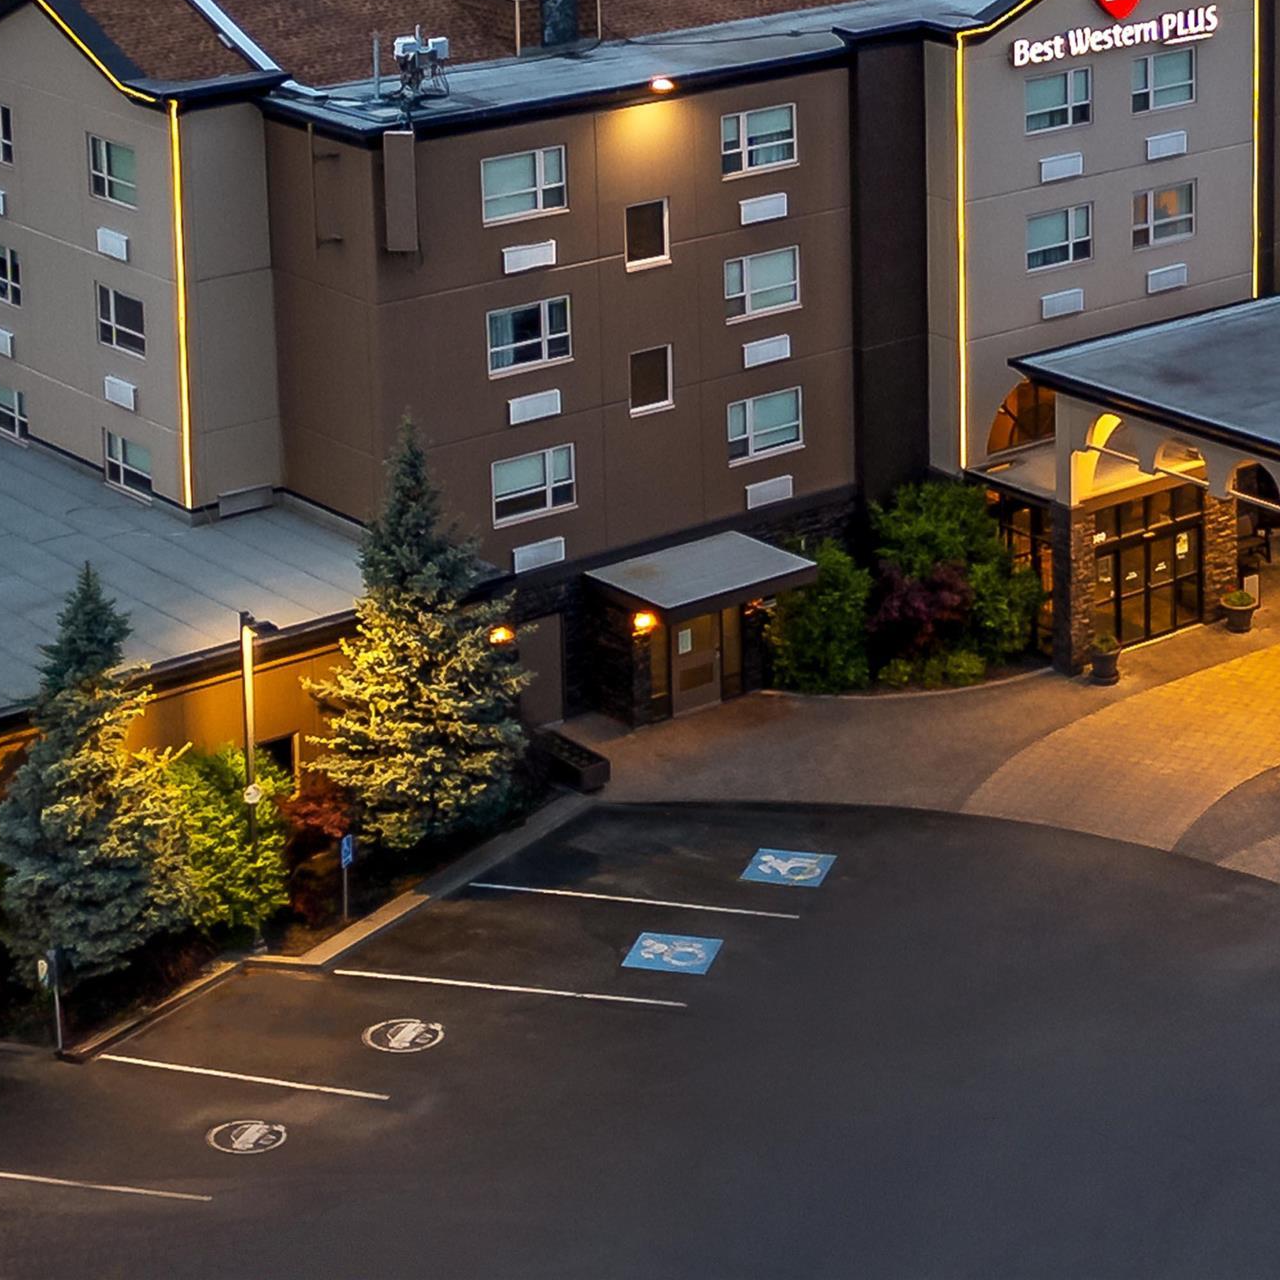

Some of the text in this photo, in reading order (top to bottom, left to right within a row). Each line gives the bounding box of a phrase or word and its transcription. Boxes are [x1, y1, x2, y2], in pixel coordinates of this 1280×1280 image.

[1013, 4, 1219, 67] Best Western PLUS
